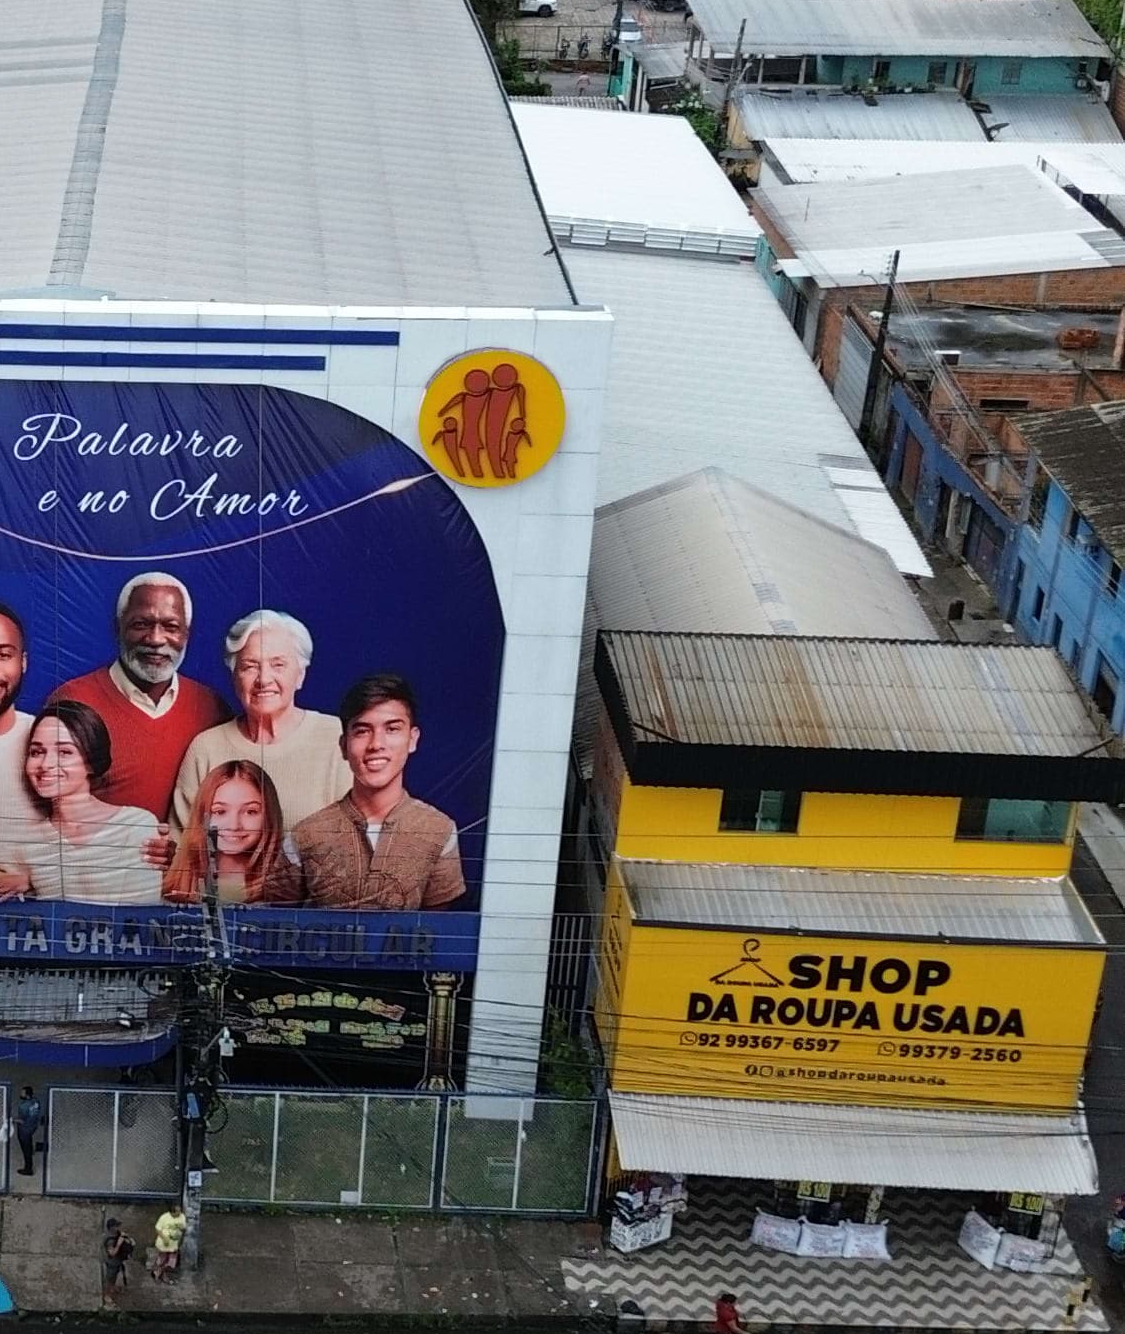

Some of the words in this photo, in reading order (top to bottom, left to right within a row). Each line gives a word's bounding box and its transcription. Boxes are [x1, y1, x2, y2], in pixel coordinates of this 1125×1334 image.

[13, 412, 243, 461] Palavra
[38, 487, 61, 513] e
[78, 487, 130, 514] no
[149, 472, 309, 521] Amor
[788, 954, 951, 996] SHOP
[687, 992, 738, 1022] DA
[749, 995, 881, 1031] ROUPA
[893, 1003, 1025, 1038] USADA
[698, 1033, 720, 1048] 92
[725, 1035, 840, 1052] 99367-6597
[898, 1043, 1023, 1063] 99379-2560
